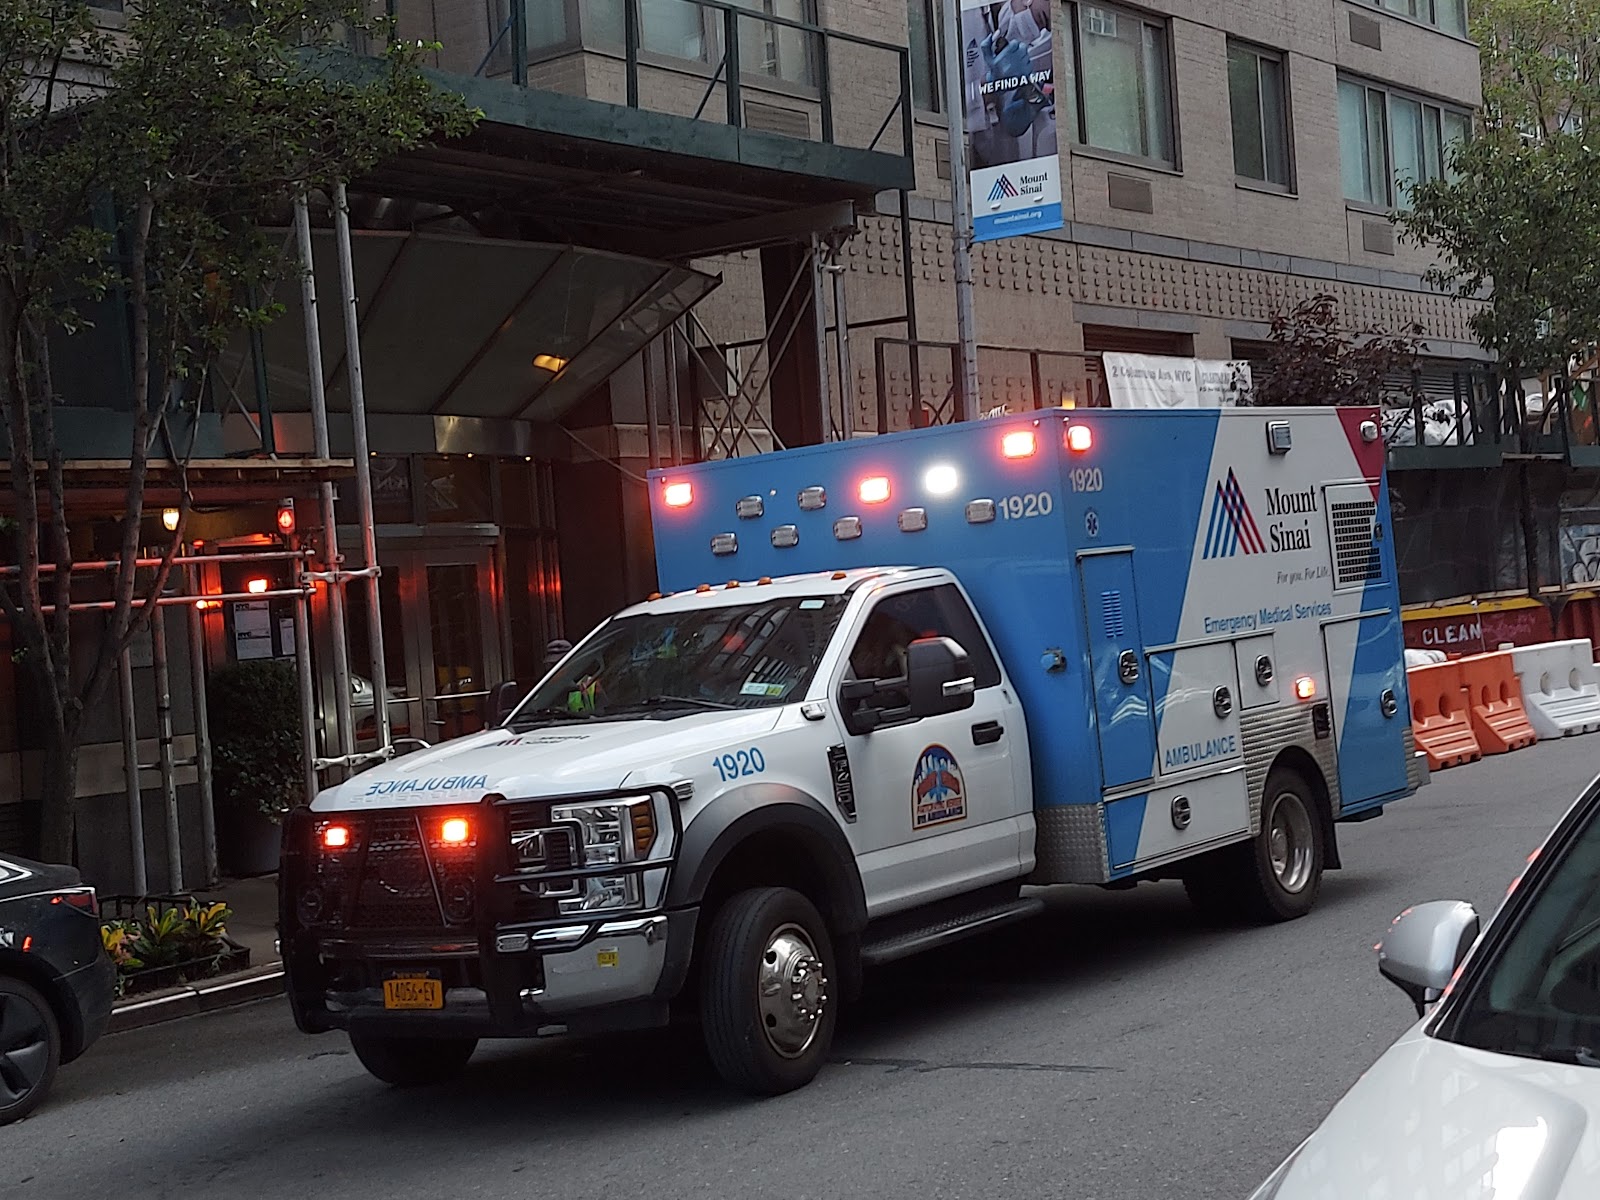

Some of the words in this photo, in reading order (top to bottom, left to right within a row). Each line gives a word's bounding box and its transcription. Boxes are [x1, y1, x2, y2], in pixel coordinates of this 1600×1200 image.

[979, 82, 994, 95] WE
[994, 76, 1019, 91] FIND
[1020, 75, 1028, 86] A
[1029, 69, 1051, 83] WAY
[1020, 172, 1048, 185] Mount
[1020, 183, 1043, 195] Sinai
[1112, 365, 1119, 378] 2
[1174, 369, 1192, 382] NYC
[1069, 467, 1103, 492] 1920
[998, 491, 1053, 520] 1920
[1265, 484, 1318, 515] Mount
[1269, 519, 1311, 553] Sinai
[1203, 613, 1258, 633] Emergency
[1259, 604, 1293, 625] Medical
[1295, 601, 1332, 620] Services
[1422, 623, 1482, 645] CLEAN
[712, 747, 765, 782] 1920
[1165, 735, 1237, 768] AMBULANCE
